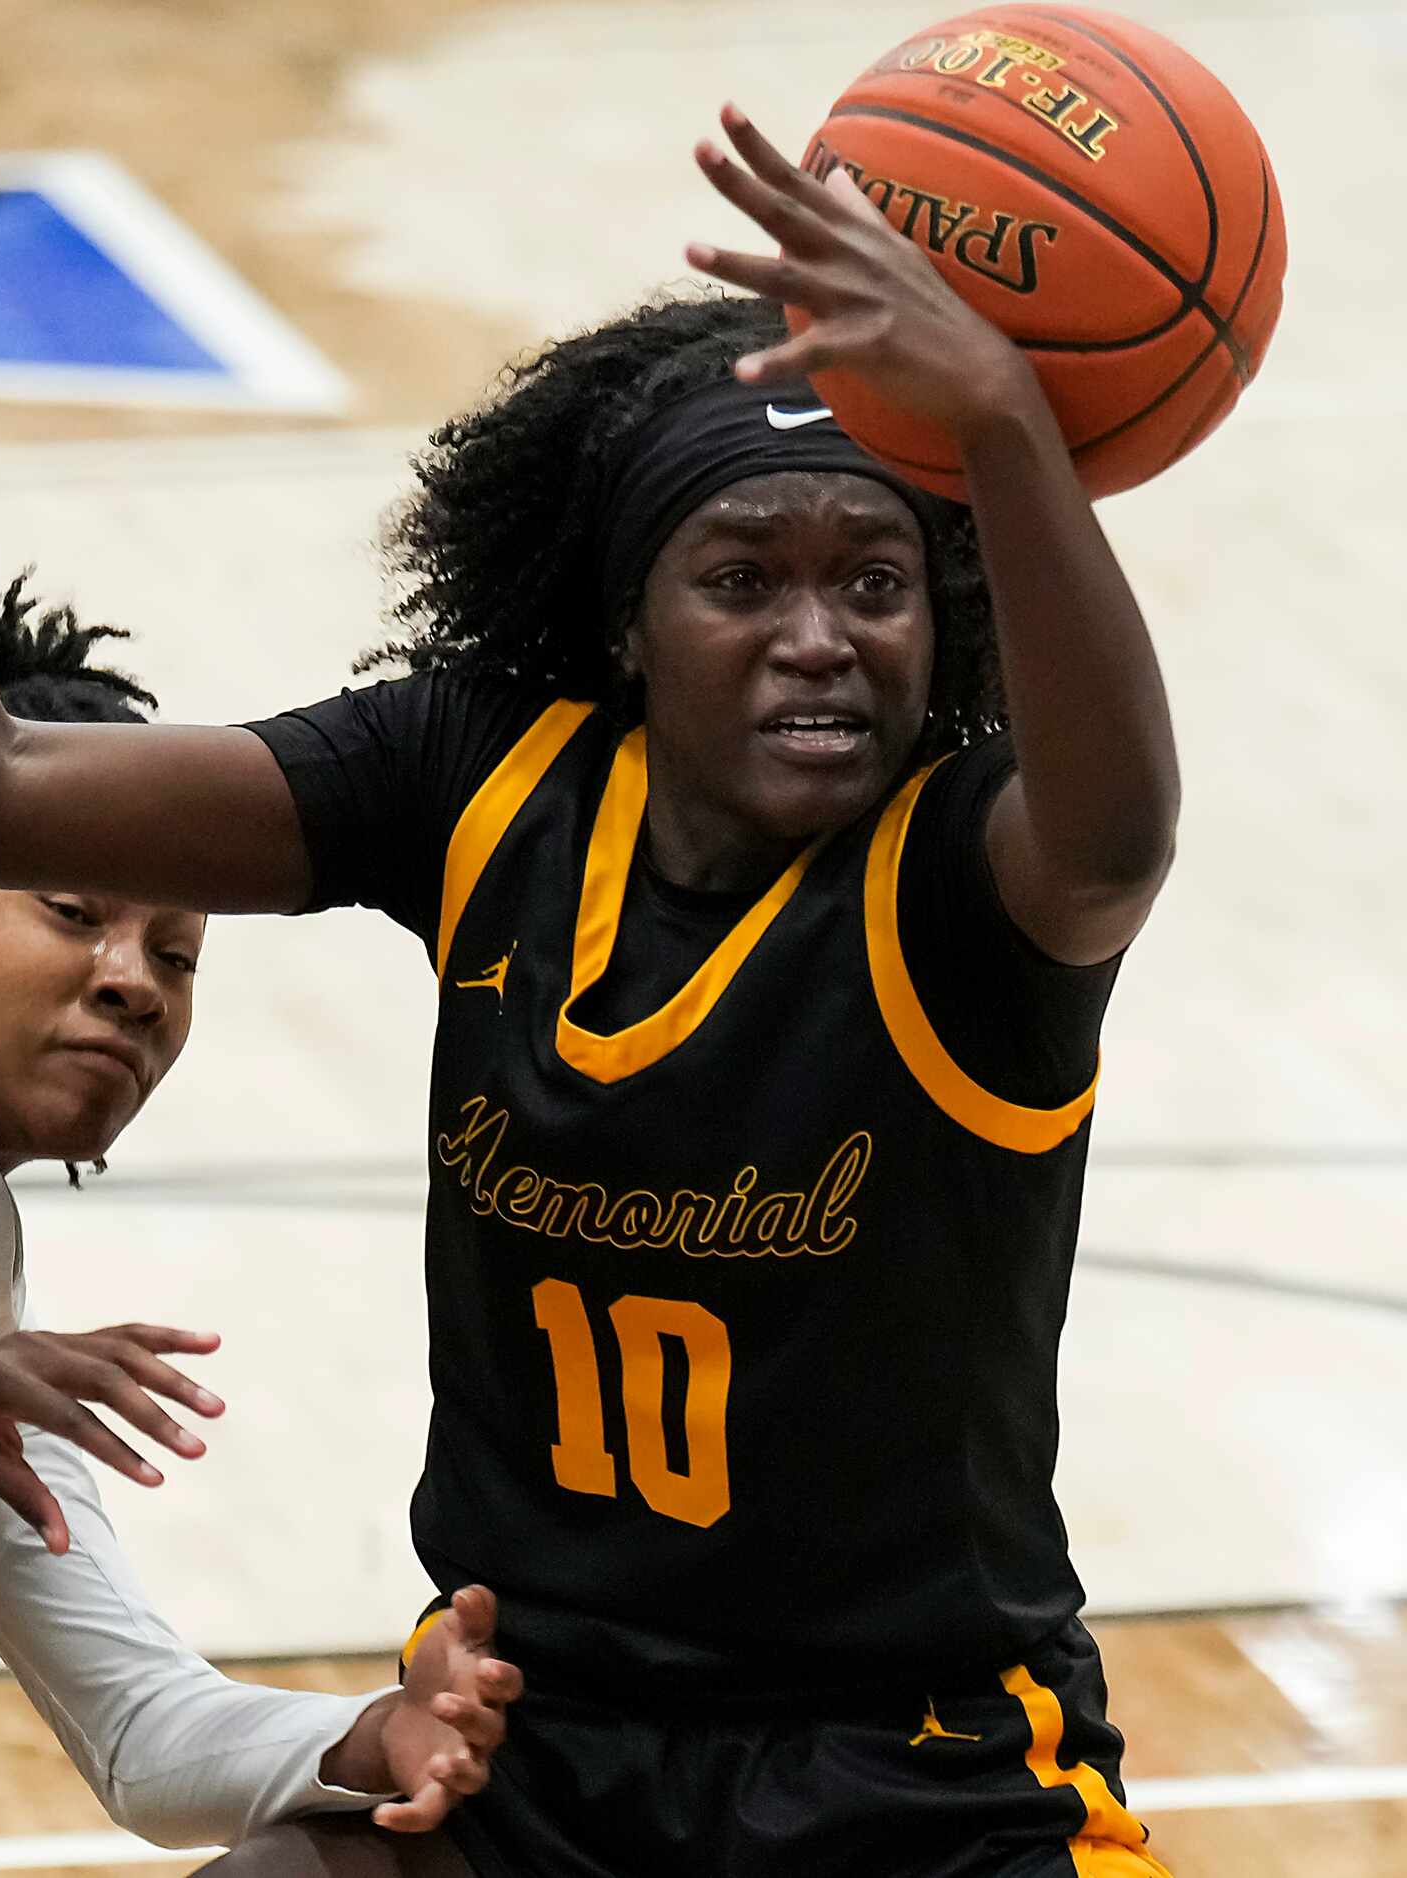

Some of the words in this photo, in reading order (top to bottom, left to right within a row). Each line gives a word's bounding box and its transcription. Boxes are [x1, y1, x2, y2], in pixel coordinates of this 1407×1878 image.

[801, 138, 1059, 296] SPALDN
[437, 1095, 872, 1258] Memorial
[531, 1277, 732, 1529] 10
